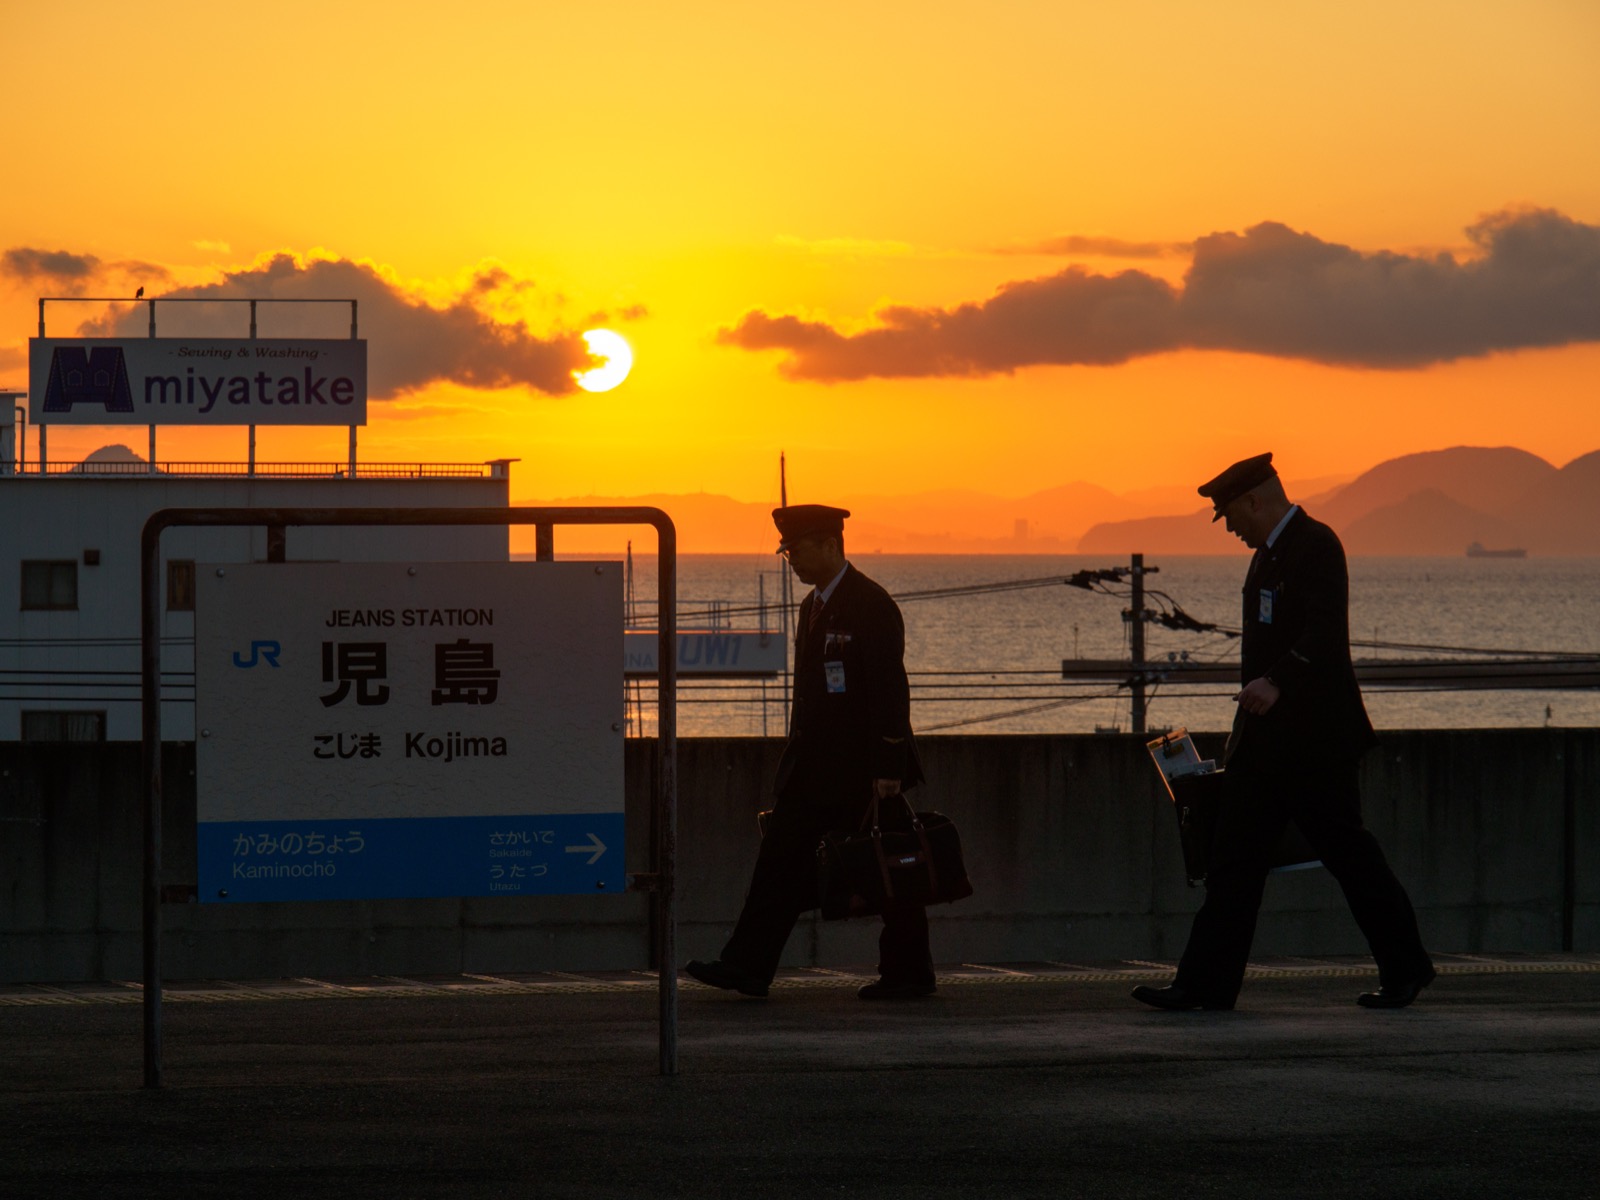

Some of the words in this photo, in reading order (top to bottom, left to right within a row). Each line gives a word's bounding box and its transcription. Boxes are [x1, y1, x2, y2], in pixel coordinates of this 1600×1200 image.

[178, 347, 232, 360] Sewing
[237, 347, 250, 358] &
[255, 347, 319, 360] Washing
[144, 366, 355, 413] miyatake
[325, 609, 395, 627] JEANS
[402, 608, 493, 626] STATION
[232, 640, 281, 668] JR
[319, 638, 501, 708] 児島
[313, 732, 382, 759] こじま
[405, 732, 508, 762] Kojima
[232, 831, 366, 857] かみのちょう
[488, 830, 556, 846] さかいで
[488, 848, 533, 858] Sakaide
[232, 860, 336, 879] Kaminochō
[489, 862, 549, 879] うたづ
[489, 882, 521, 891] Utazu
